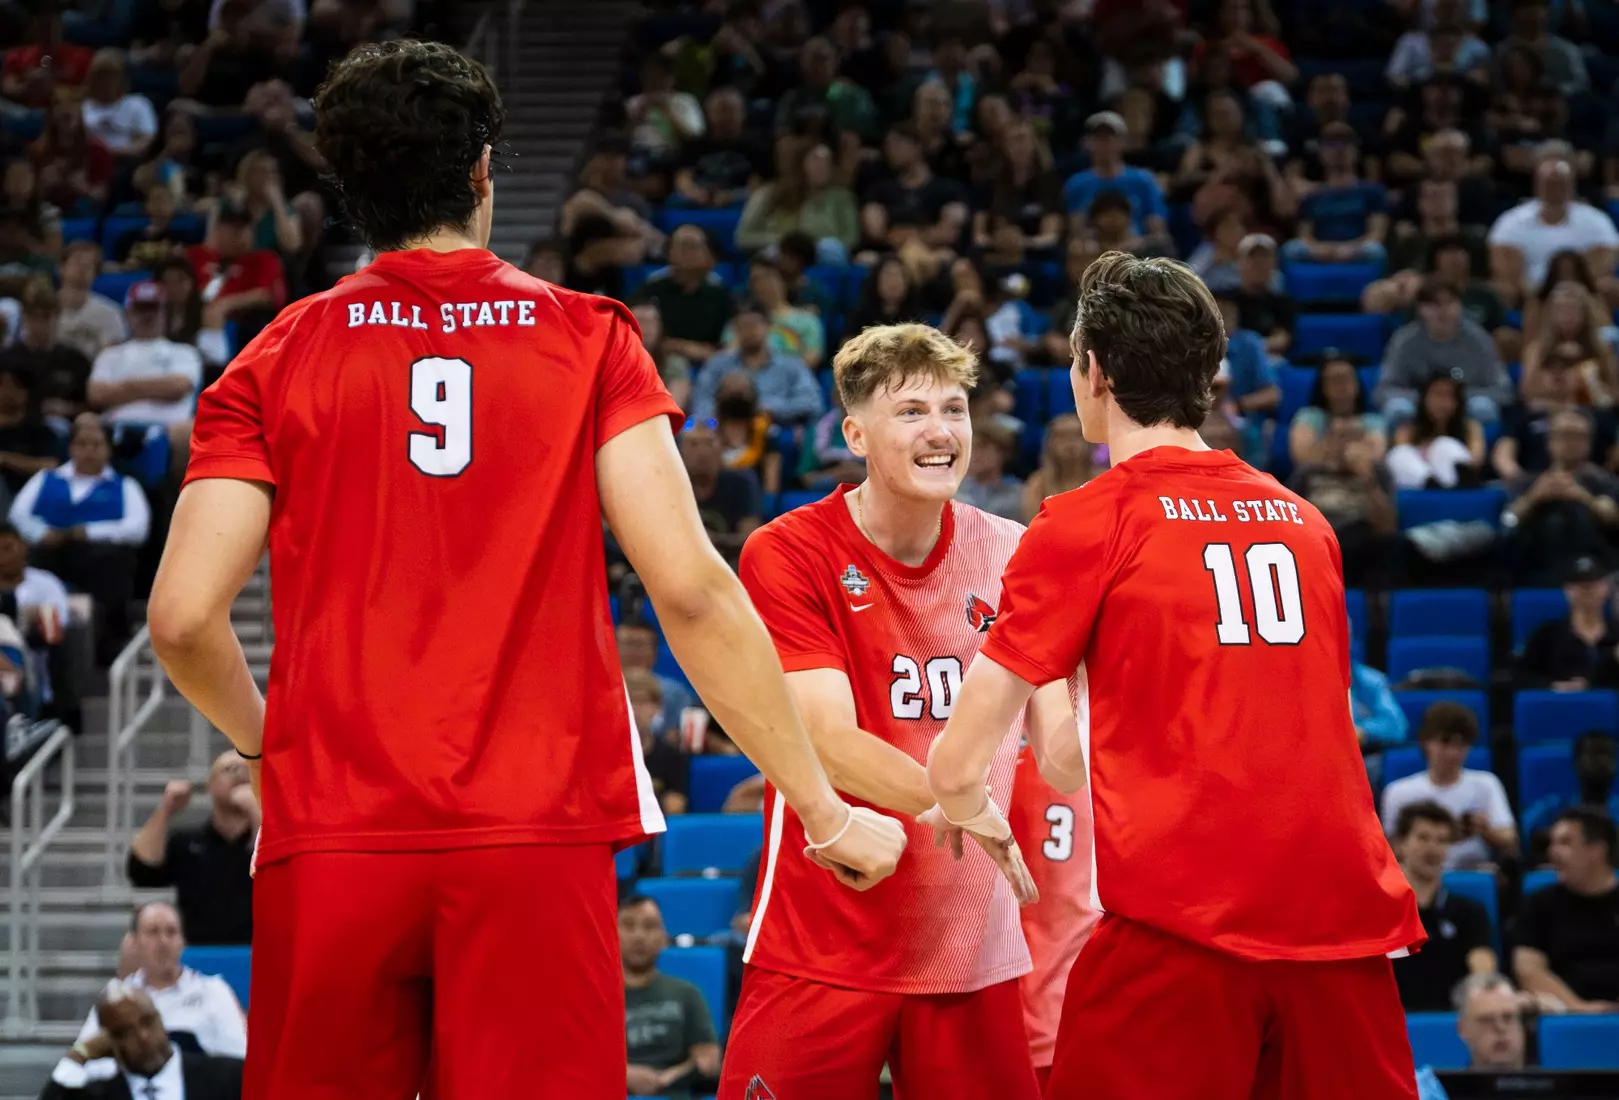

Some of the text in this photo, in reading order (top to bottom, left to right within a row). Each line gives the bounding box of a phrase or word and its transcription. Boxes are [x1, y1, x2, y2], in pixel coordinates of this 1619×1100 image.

[348, 300, 536, 333] BALL STATE
[407, 355, 474, 478] 9
[1158, 496, 1304, 525] BALL STATE
[1202, 541, 1307, 646] 10
[889, 653, 963, 720] 20
[1042, 804, 1076, 861] 3
